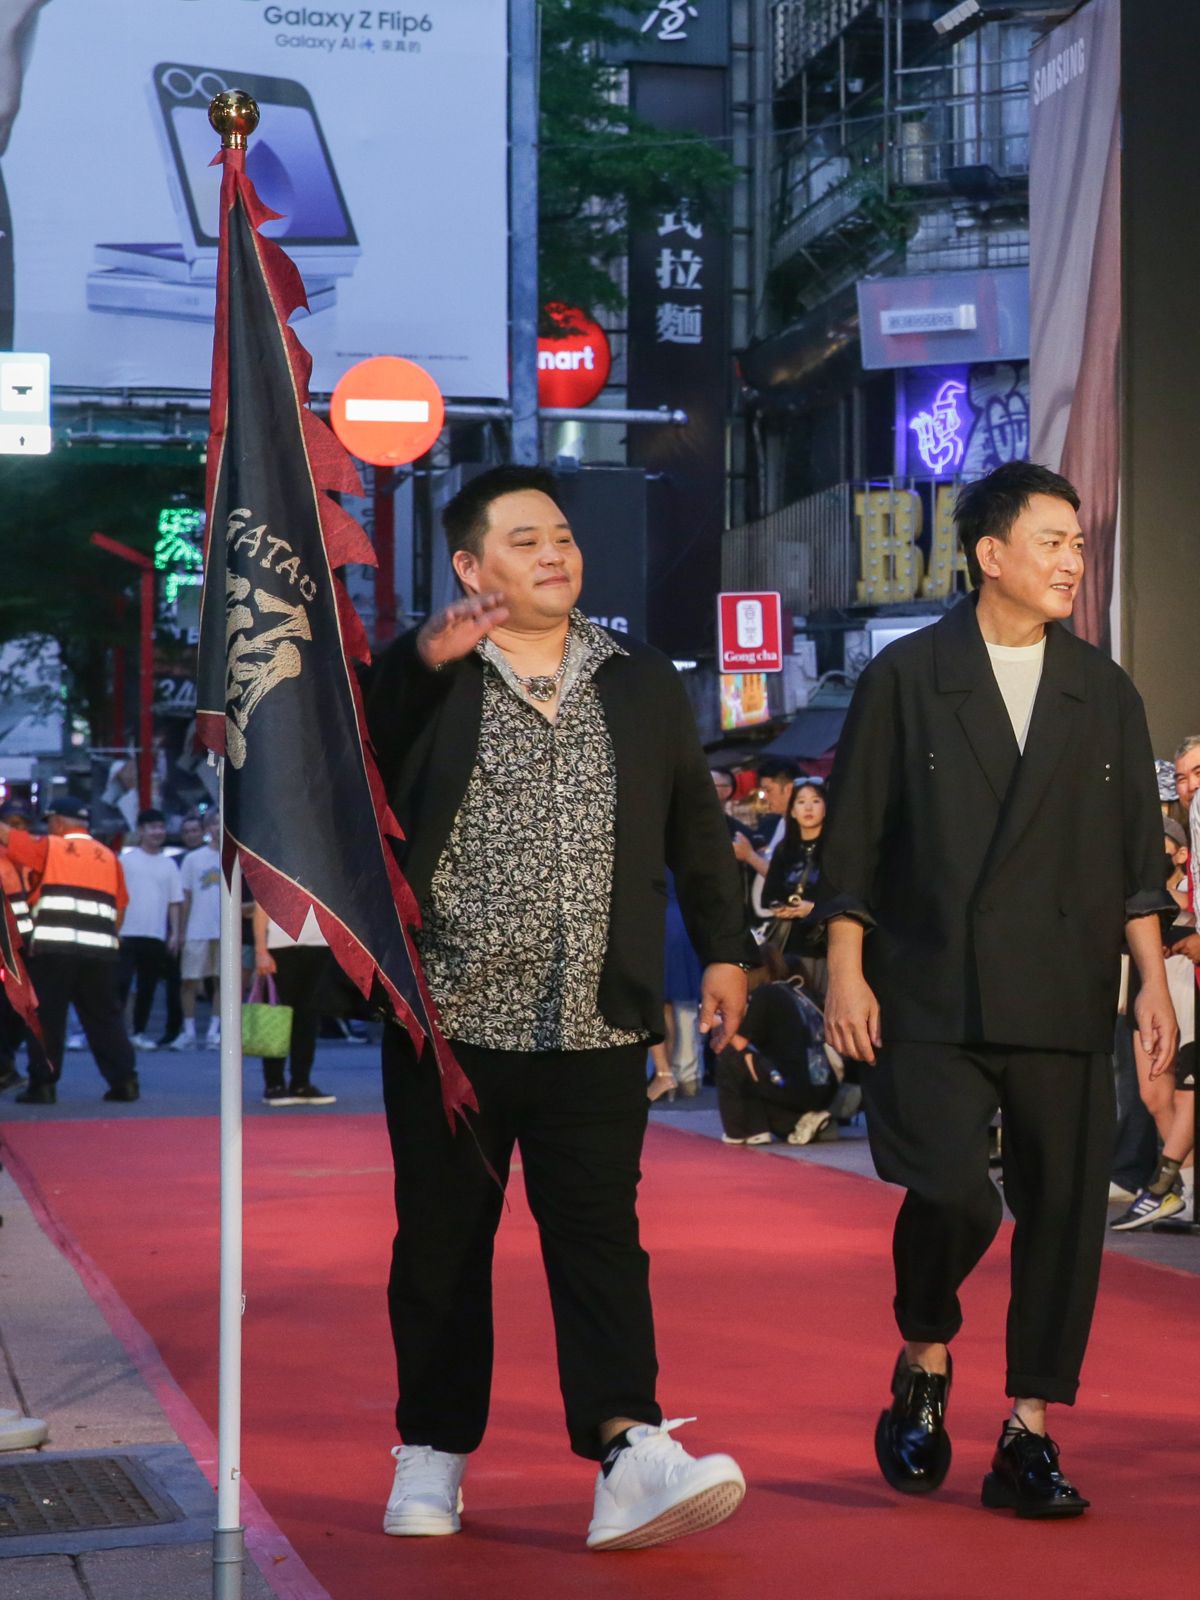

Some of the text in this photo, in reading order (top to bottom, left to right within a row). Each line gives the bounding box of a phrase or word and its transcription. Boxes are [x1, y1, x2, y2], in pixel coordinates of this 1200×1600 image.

[264, 6, 432, 37] Galaxy Z Flip6
[275, 34, 336, 52] Galaxy
[340, 38, 355, 50] AI
[1034, 37, 1084, 106] SAMSUNG
[724, 649, 777, 664] Gong cha
